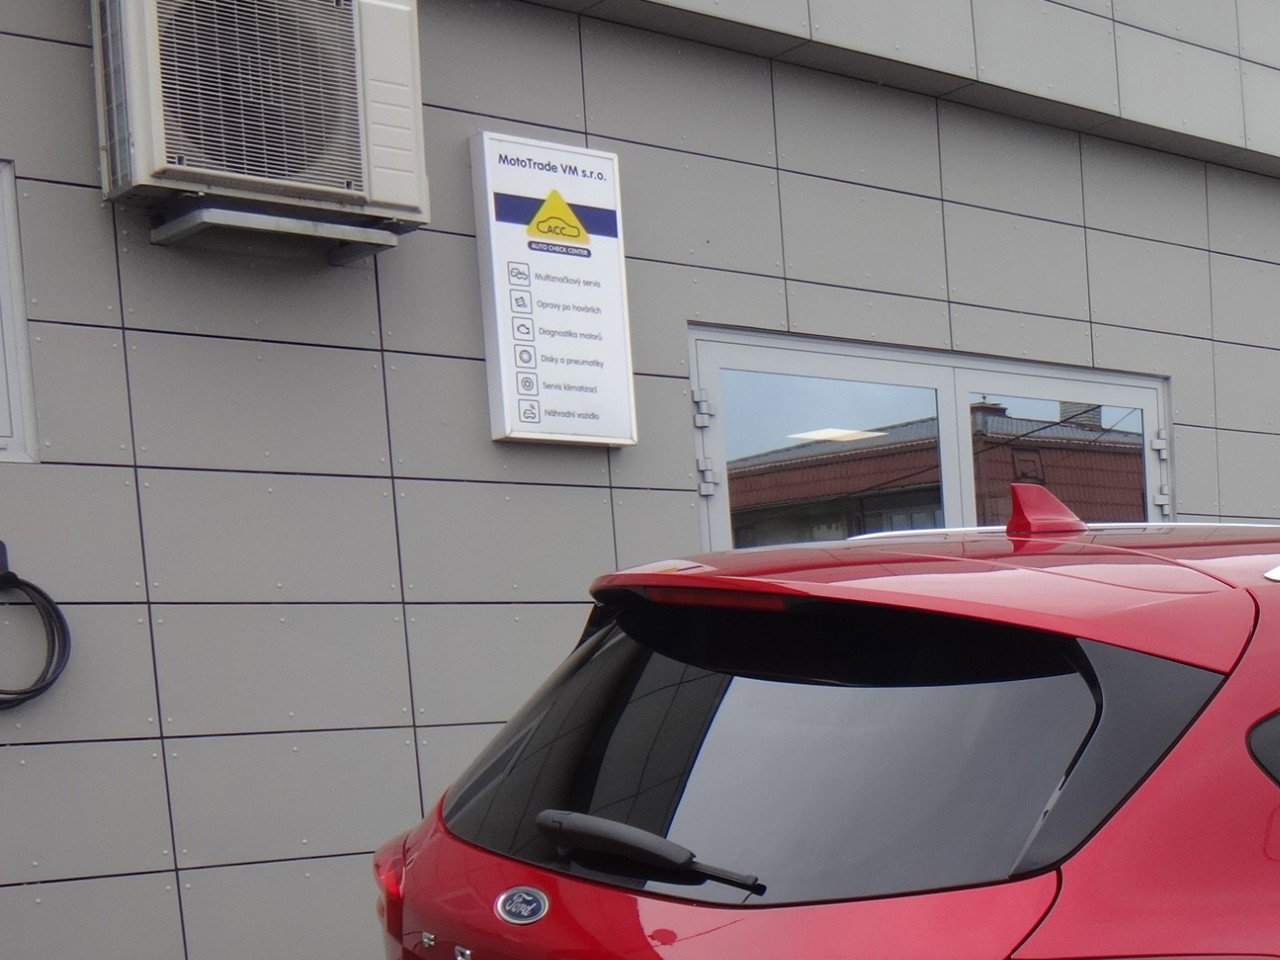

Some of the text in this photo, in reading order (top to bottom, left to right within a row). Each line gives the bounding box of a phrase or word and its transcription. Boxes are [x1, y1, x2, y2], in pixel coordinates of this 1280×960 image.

[498, 154, 607, 181] MotoTrade VM s.r.o.
[547, 225, 566, 236] ACC
[531, 242, 589, 256] AUTO CHECK CENTER
[582, 279, 601, 288] servis
[536, 299, 561, 311] Opravy
[562, 303, 571, 311] po
[538, 327, 578, 338] Diagnostika
[541, 354, 559, 365] Disky
[565, 358, 604, 369] pneumatiky
[543, 381, 562, 390] Servis
[576, 411, 600, 420] vozidlo
[505, 892, 537, 916] Ford
